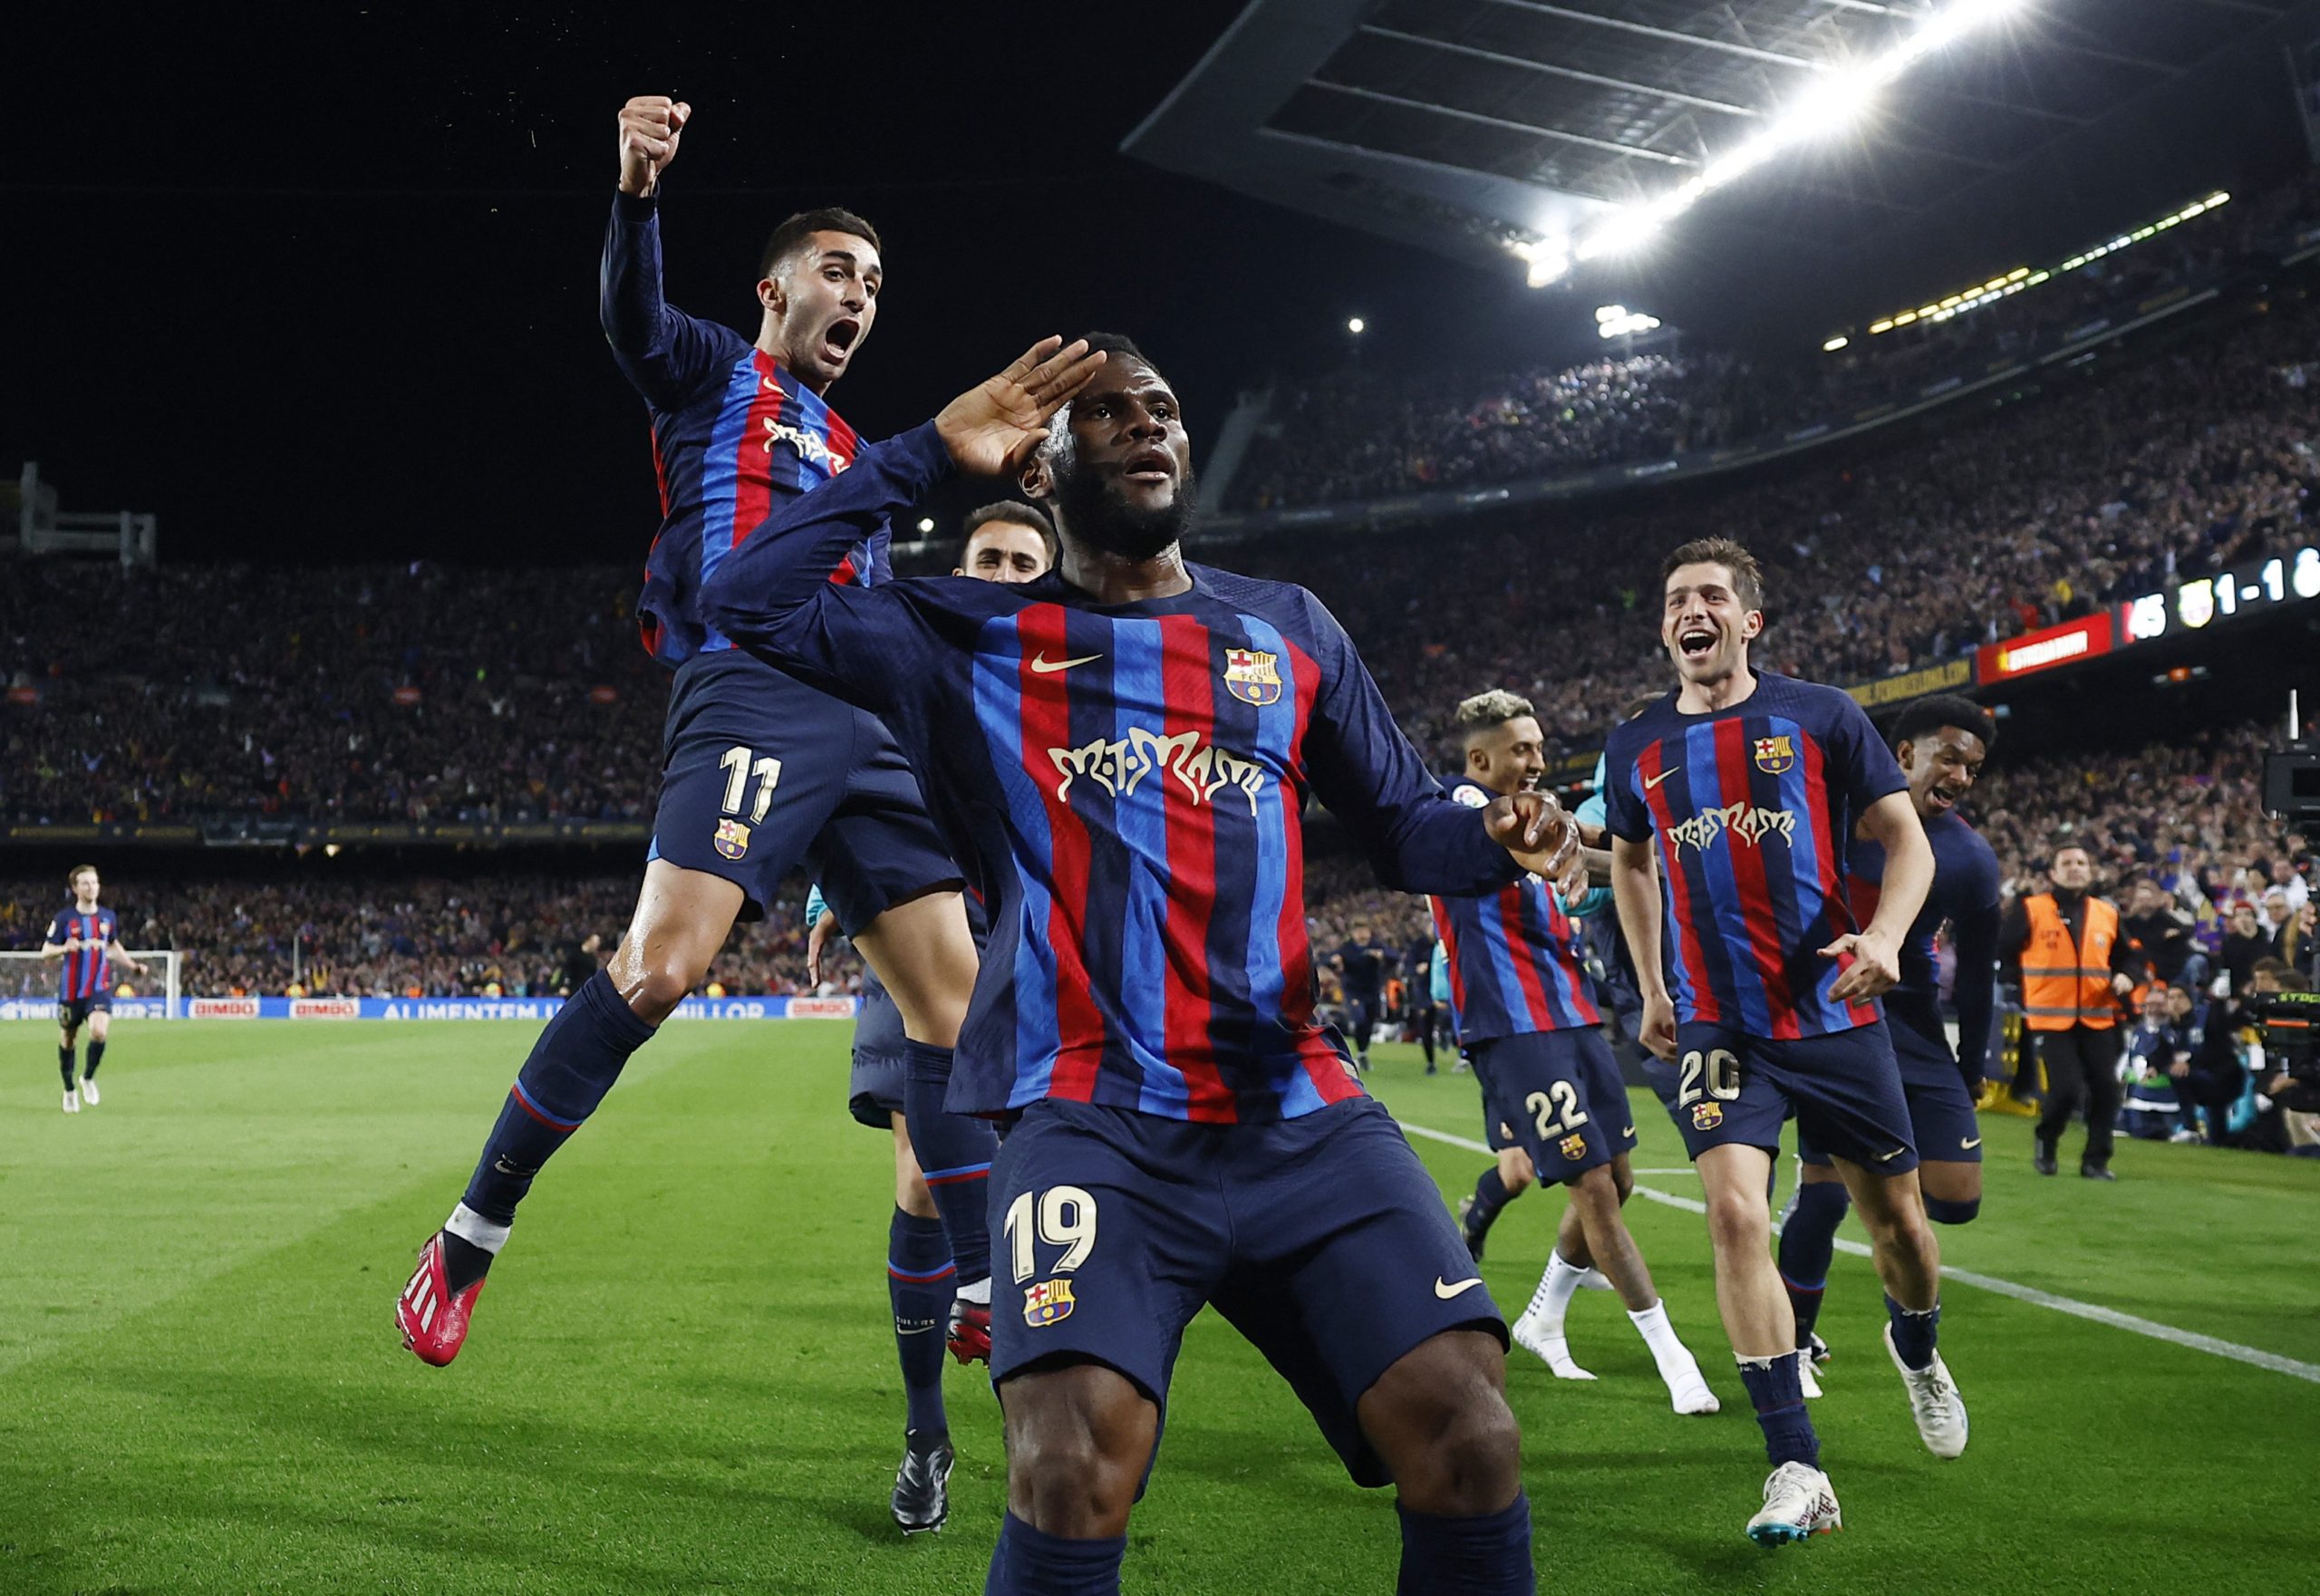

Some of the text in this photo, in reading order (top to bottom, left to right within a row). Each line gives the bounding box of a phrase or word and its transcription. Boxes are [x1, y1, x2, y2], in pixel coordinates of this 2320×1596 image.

[720, 746, 782, 826] 11
[195, 1003, 256, 1016] BIMBO
[295, 1003, 354, 1015] BIMBO
[383, 1003, 538, 1019] ALIMENTEM
[1678, 1049, 1741, 1110] 20
[1525, 1080, 1589, 1141] 22
[1003, 1185, 1097, 1285] 19
